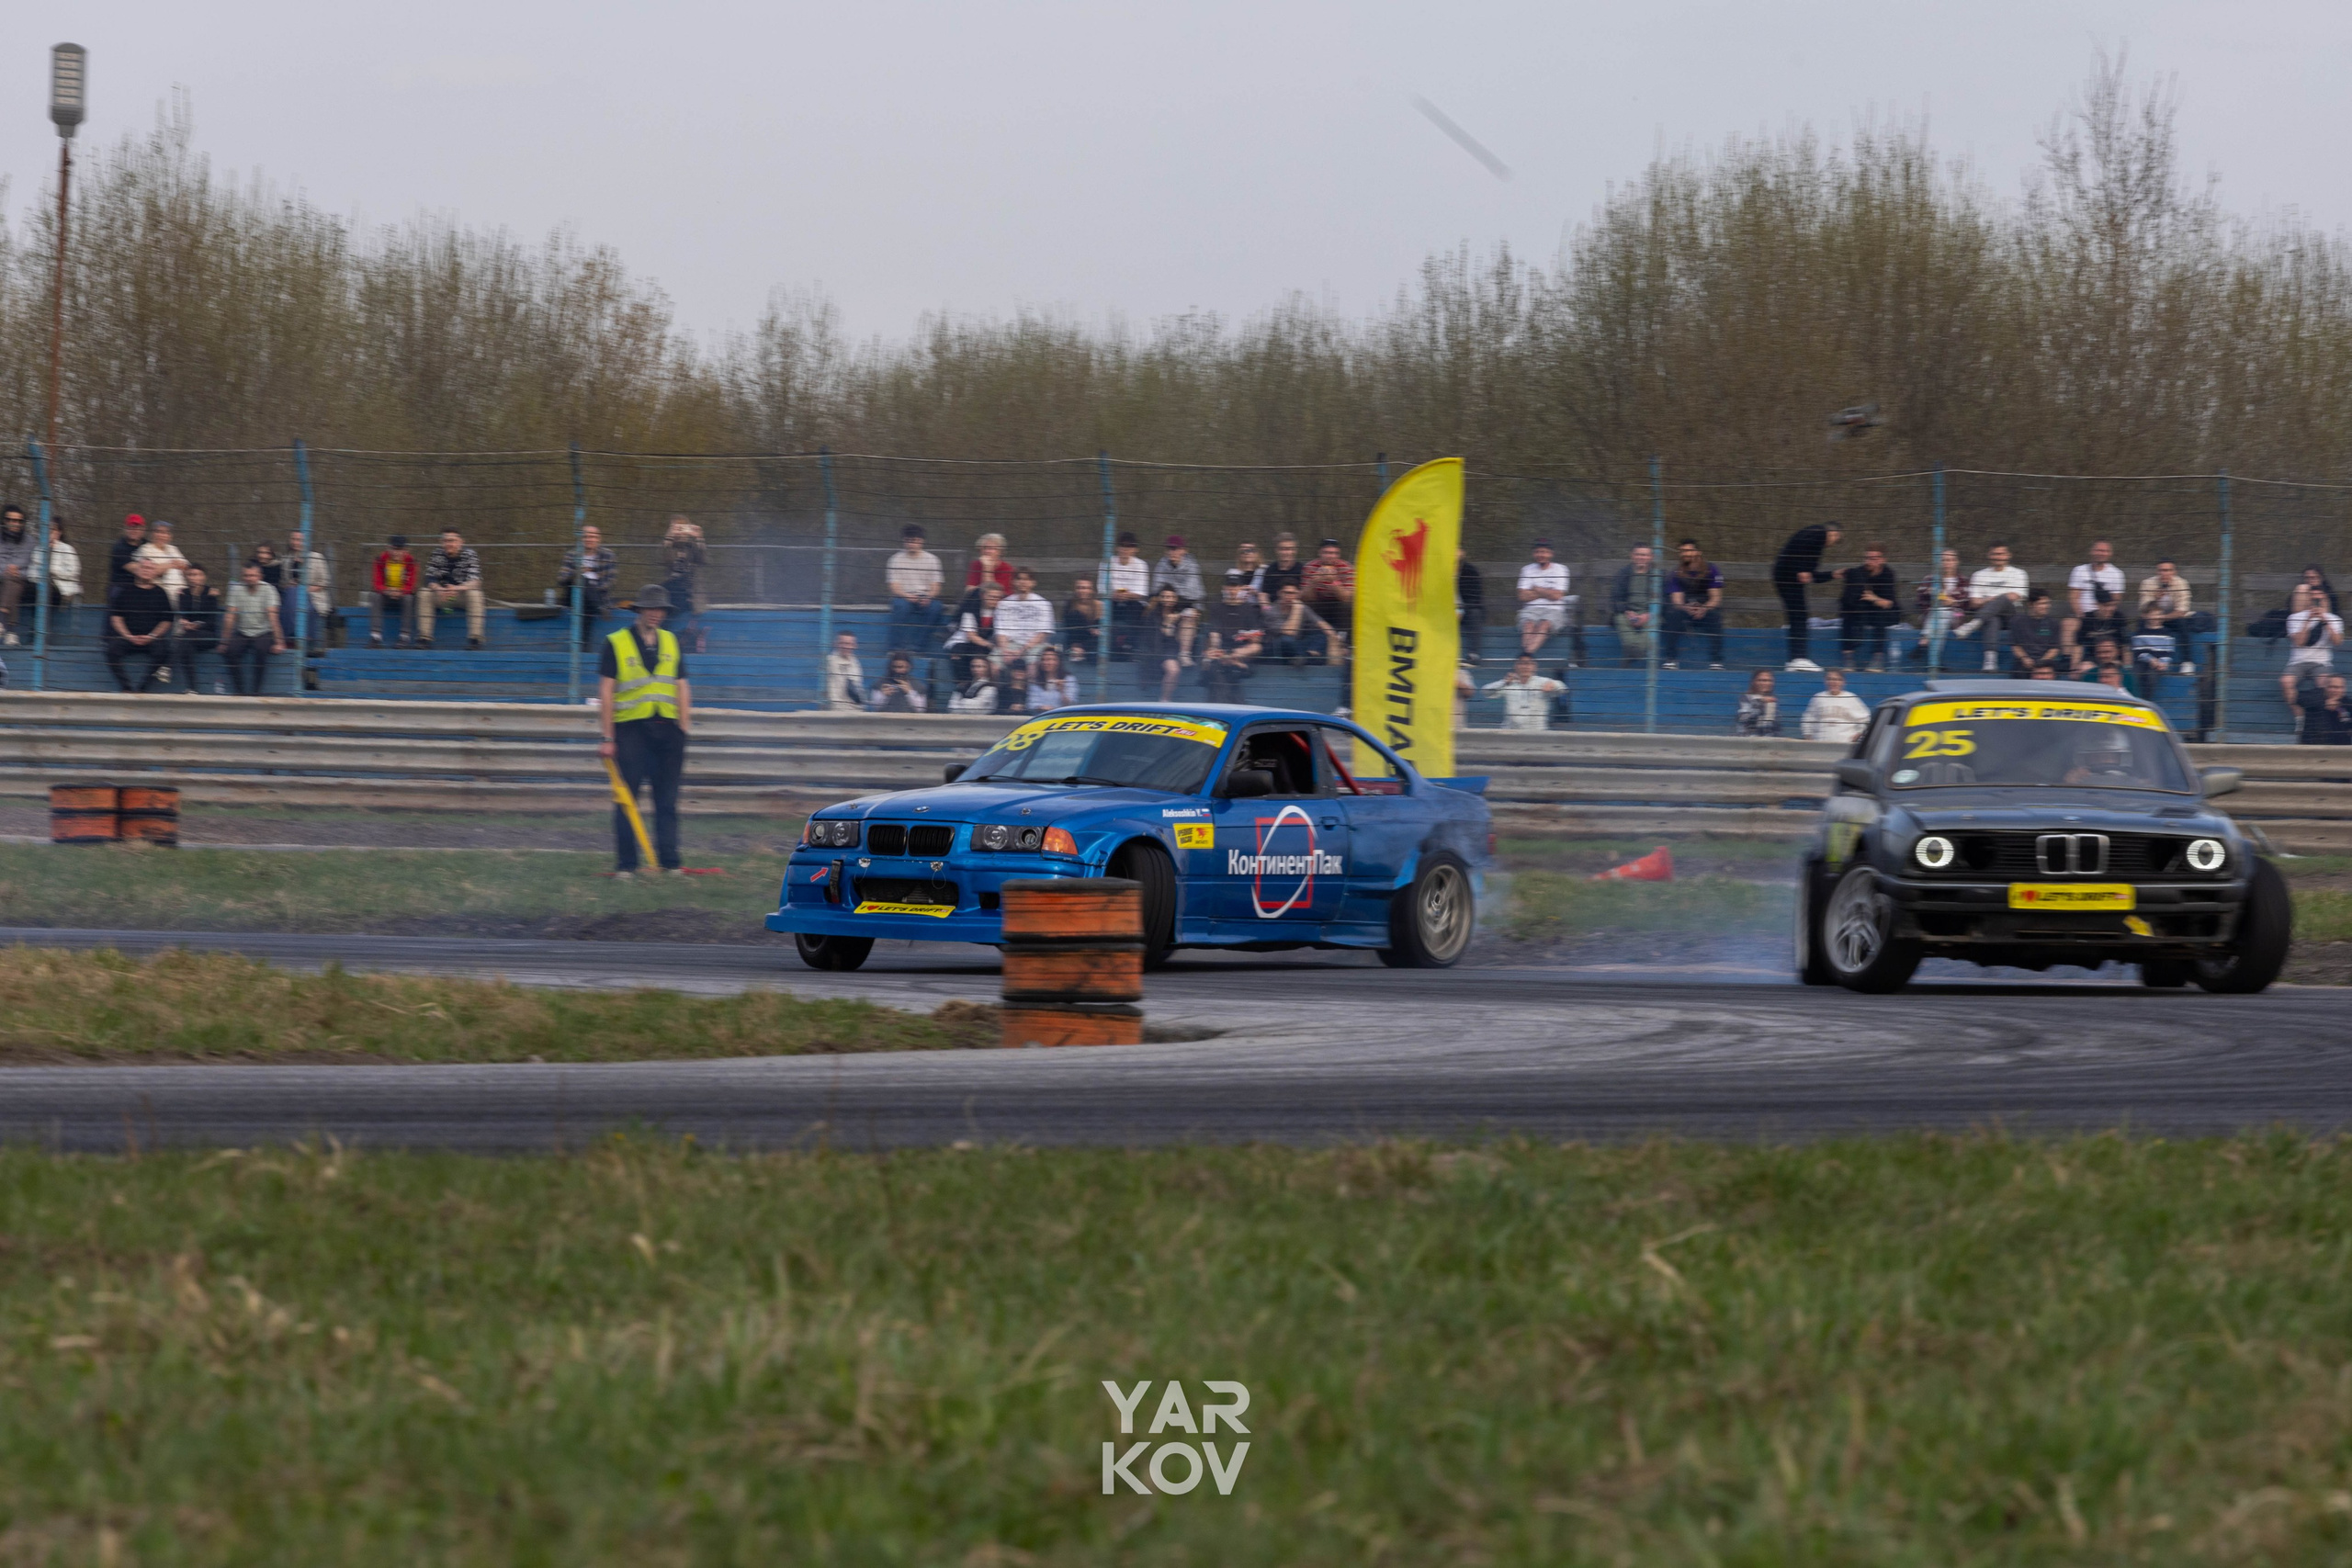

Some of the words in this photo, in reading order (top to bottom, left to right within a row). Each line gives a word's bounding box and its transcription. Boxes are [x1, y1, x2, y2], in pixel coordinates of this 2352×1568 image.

[1953, 706, 2031, 719] LET'S
[2039, 707, 2121, 722] DRIFT
[1045, 720, 1107, 732] LET'S
[1107, 721, 1182, 736] DRIFT
[983, 731, 1046, 757] 98
[1902, 729, 1977, 760] 25
[1227, 849, 1343, 875] КонтинентПак
